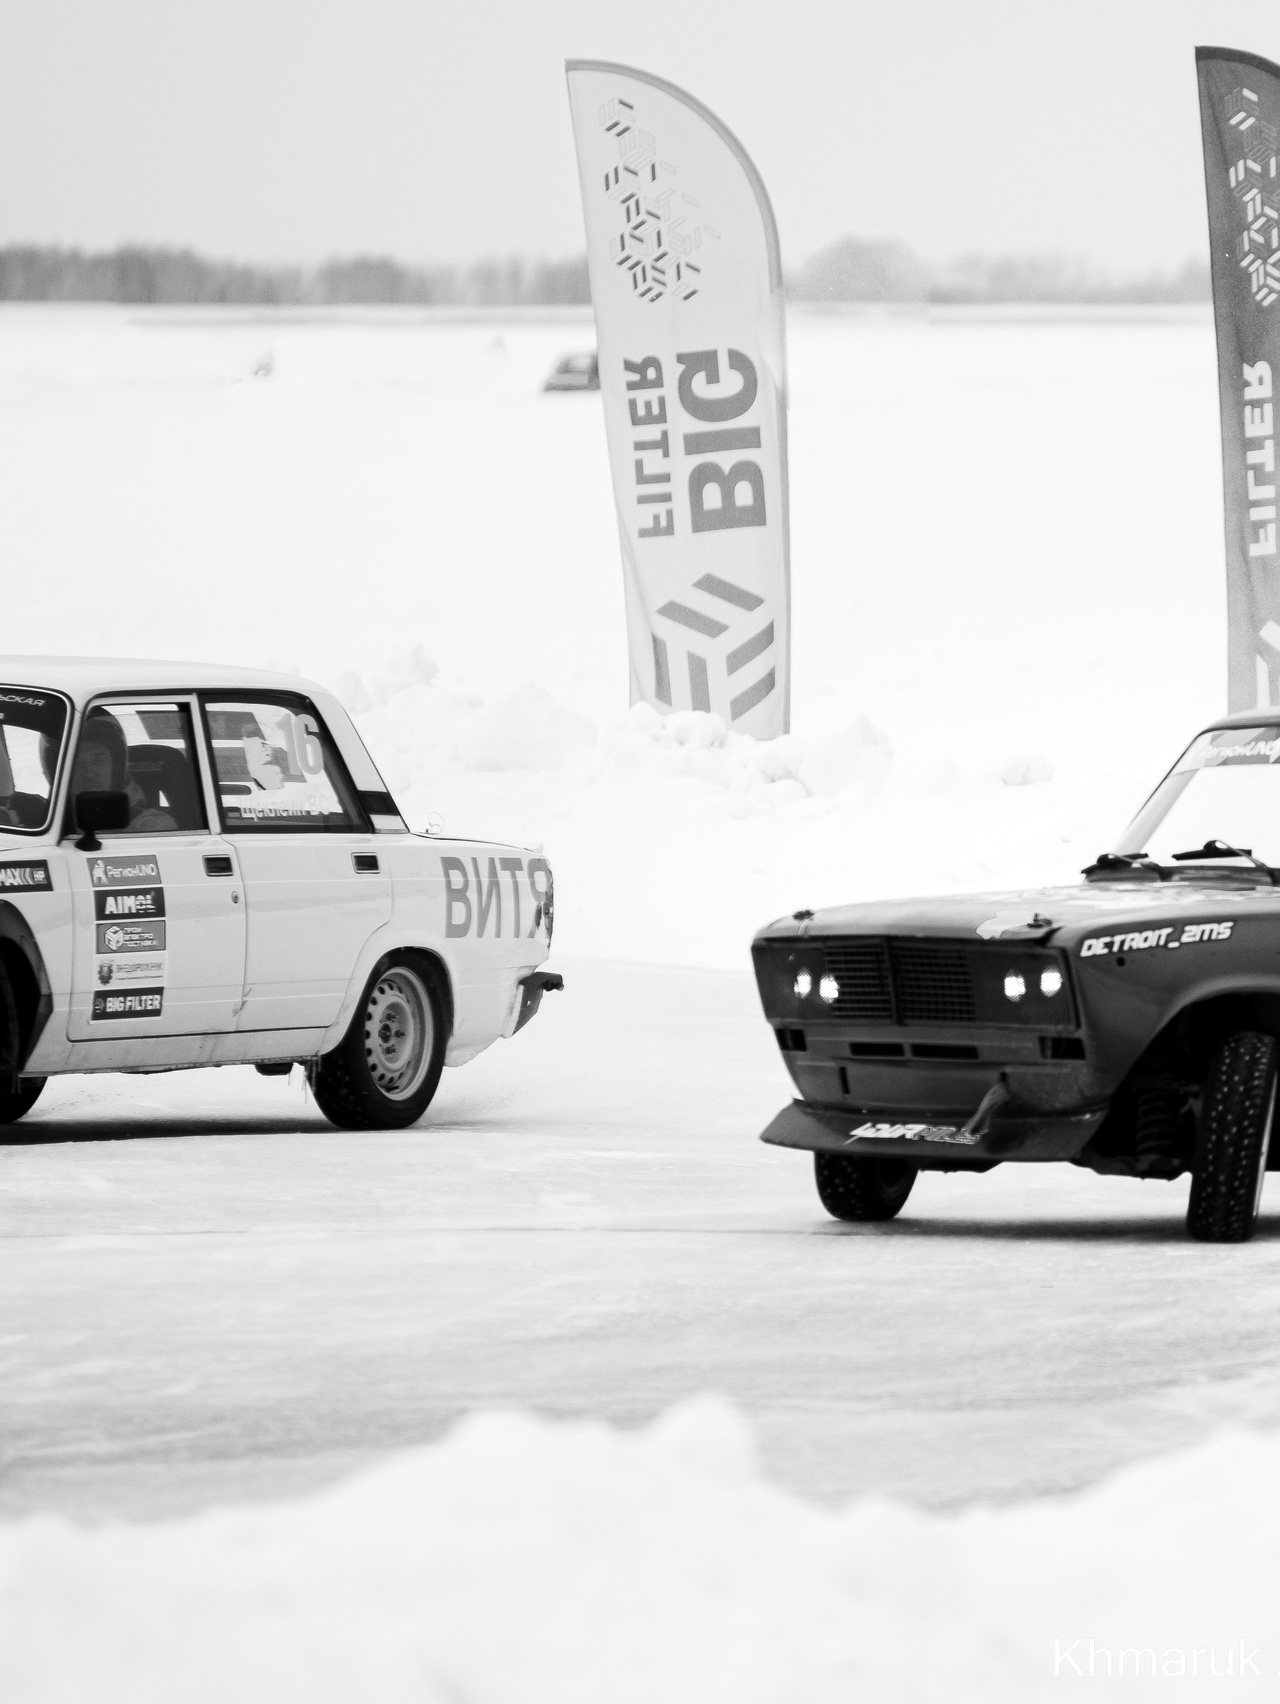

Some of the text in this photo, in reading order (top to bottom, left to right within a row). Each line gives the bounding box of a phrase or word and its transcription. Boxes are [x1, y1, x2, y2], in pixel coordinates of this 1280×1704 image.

[275, 713, 324, 776] 16
[105, 894, 156, 915] AIMOL
[440, 856, 552, 939] ВИТЯ
[106, 995, 161, 1012] BIG FILTER
